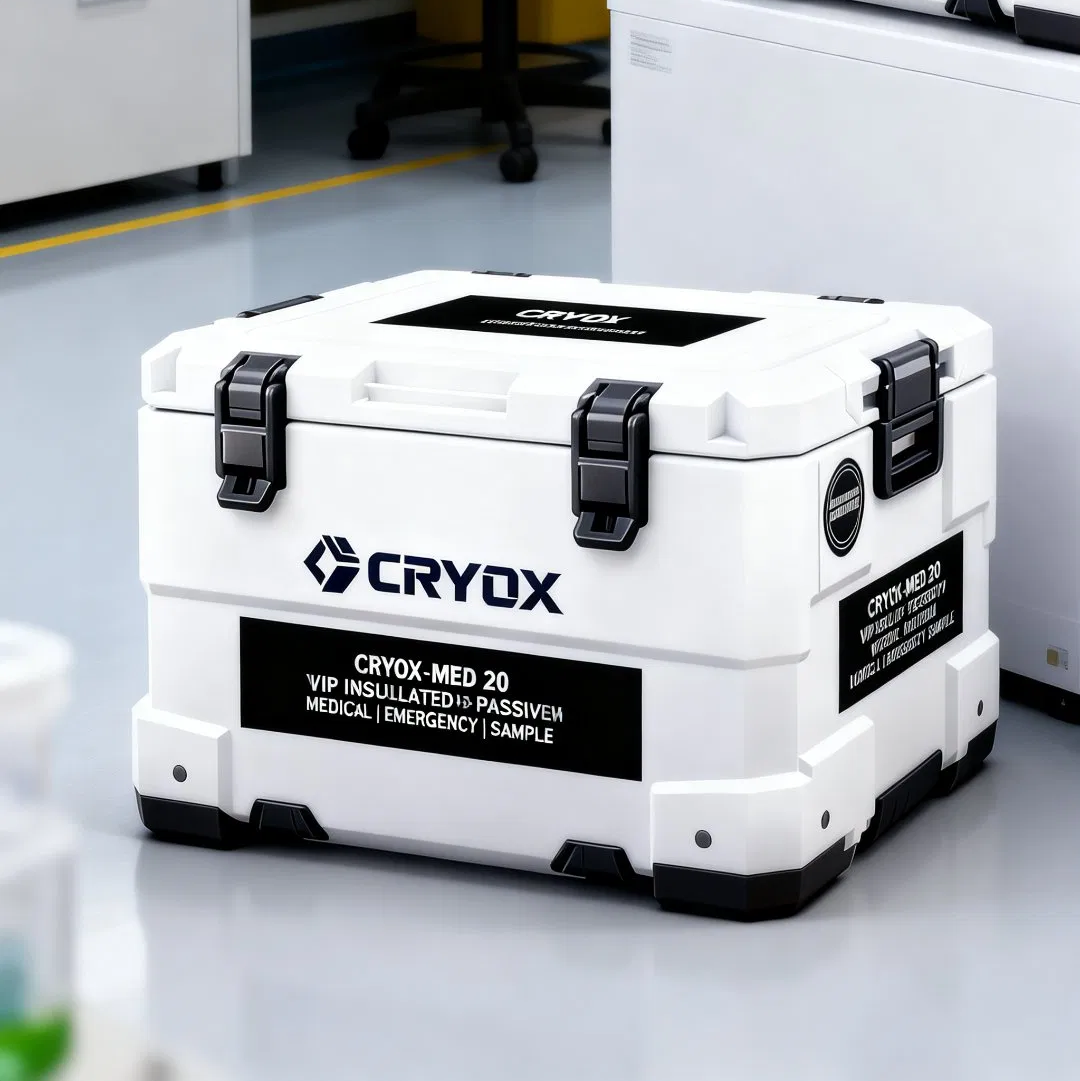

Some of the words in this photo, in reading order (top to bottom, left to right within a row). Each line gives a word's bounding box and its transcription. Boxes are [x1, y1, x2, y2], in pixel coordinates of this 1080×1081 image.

[368, 552, 564, 615] CRYOX
[928, 560, 941, 584] 20
[306, 674, 339, 693] VIP
[354, 653, 477, 688] CRYOX-MED
[482, 670, 510, 693] 20
[306, 695, 373, 720] MEDICAL
[384, 705, 479, 734] EMERGENCY
[490, 720, 554, 744] SAMPLE
